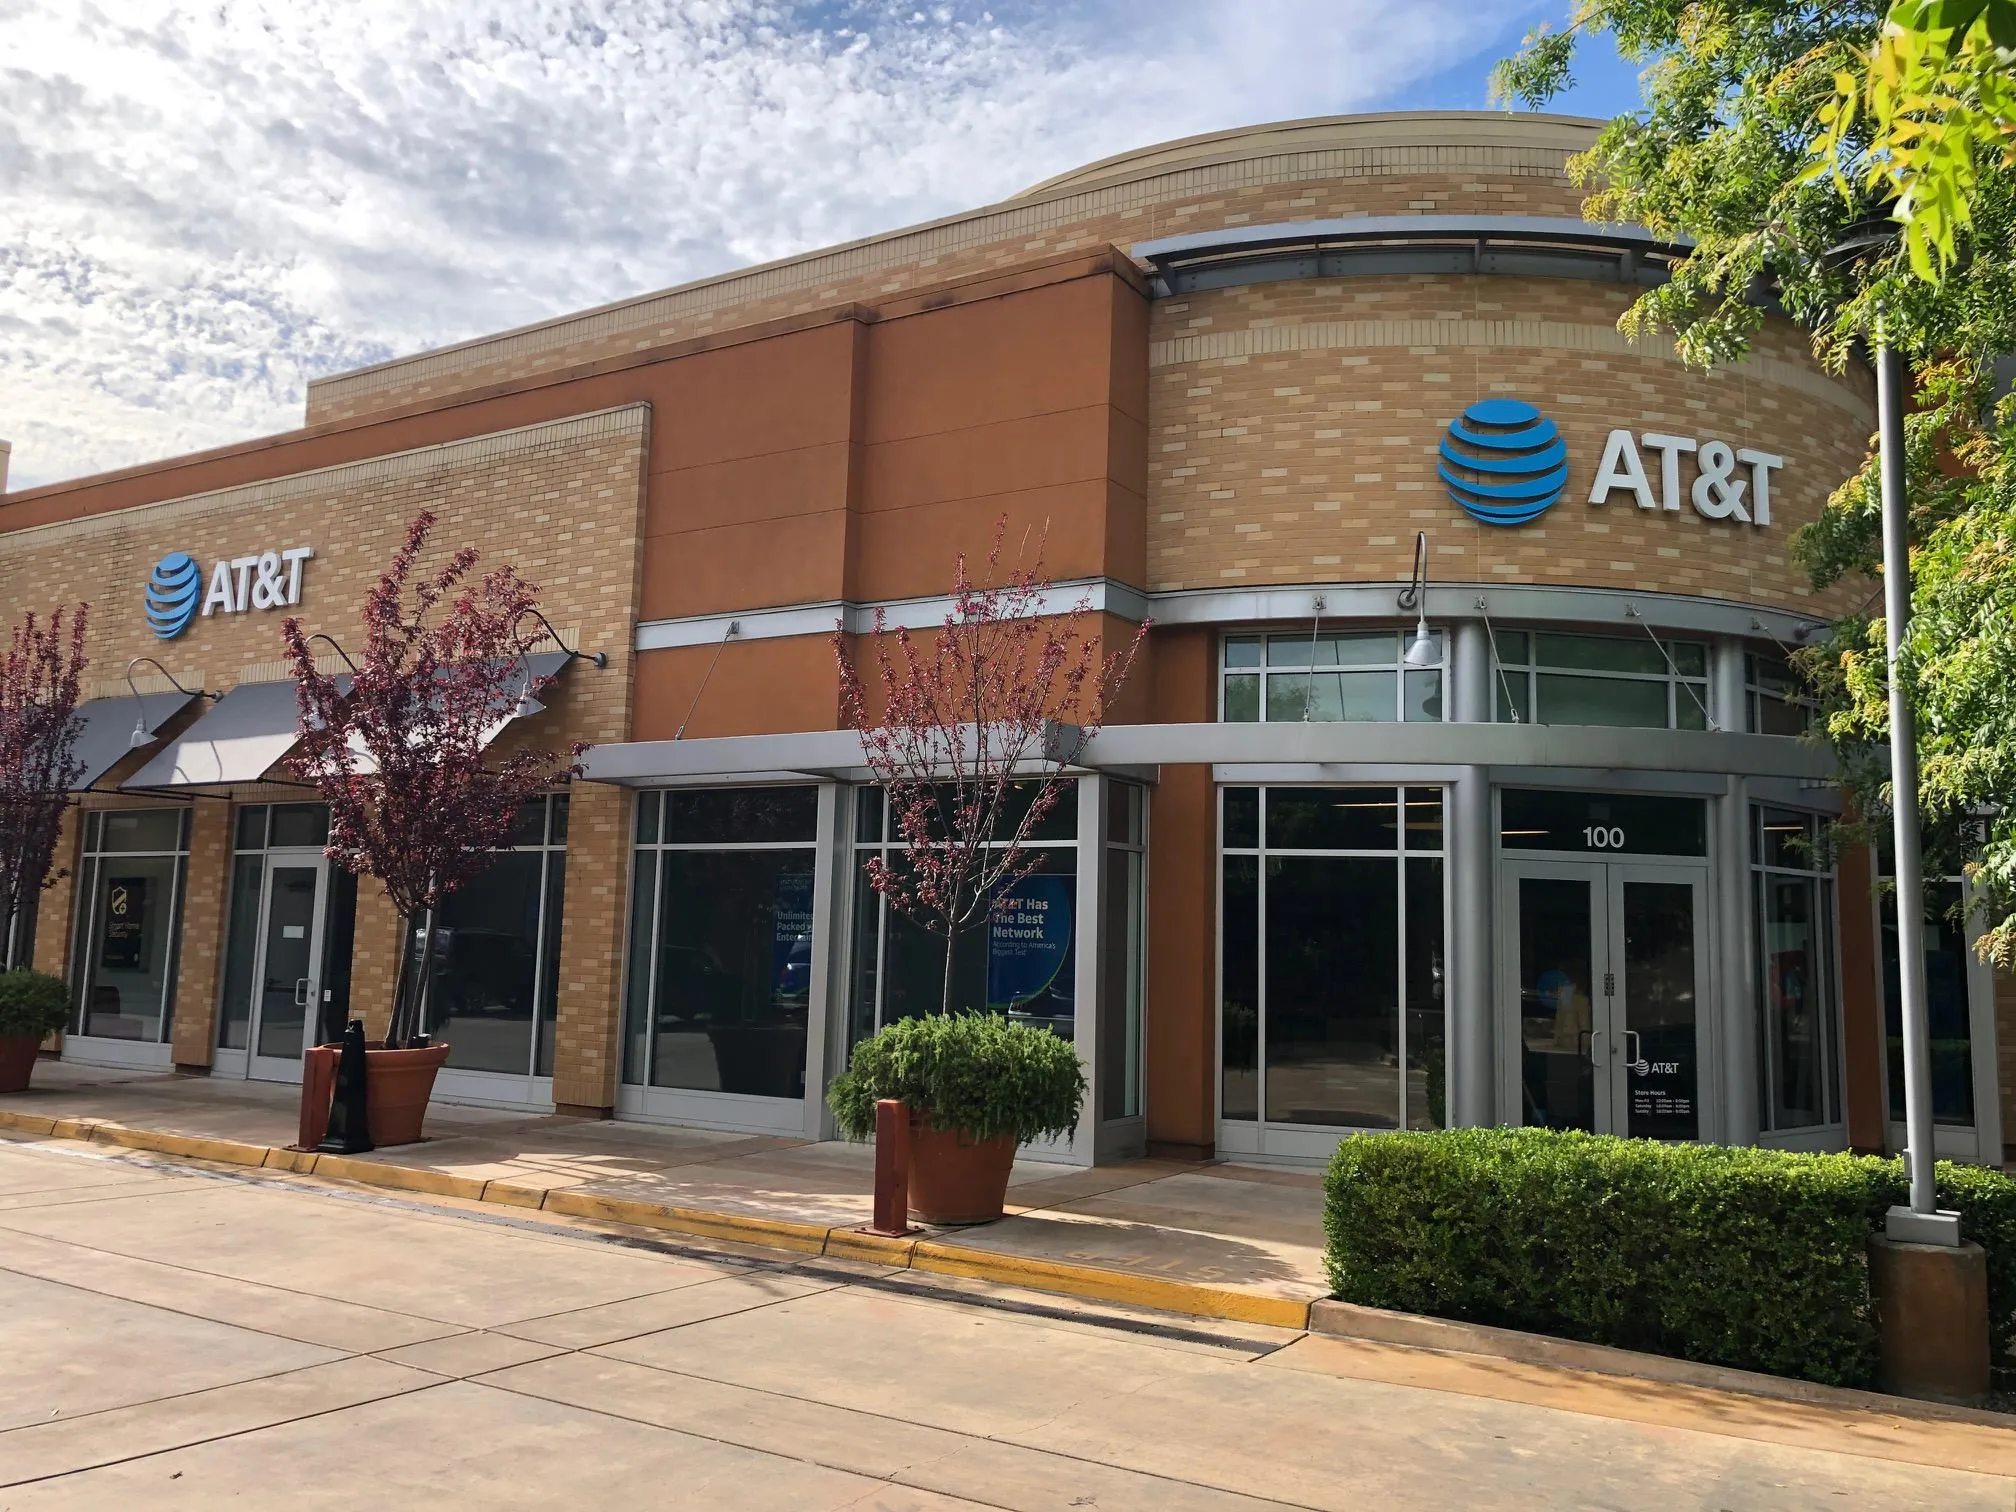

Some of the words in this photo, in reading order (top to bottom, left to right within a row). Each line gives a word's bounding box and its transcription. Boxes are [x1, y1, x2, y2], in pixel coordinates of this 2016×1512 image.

[1588, 429, 1783, 526] AT&T
[201, 546, 315, 616] AT&T
[1582, 826, 1625, 849] 100
[1026, 898, 1049, 909] Has
[1017, 912, 1044, 923] Best
[776, 921, 806, 931] Packed
[993, 926, 1044, 938] Network
[1651, 1062, 1679, 1073] AT&T
